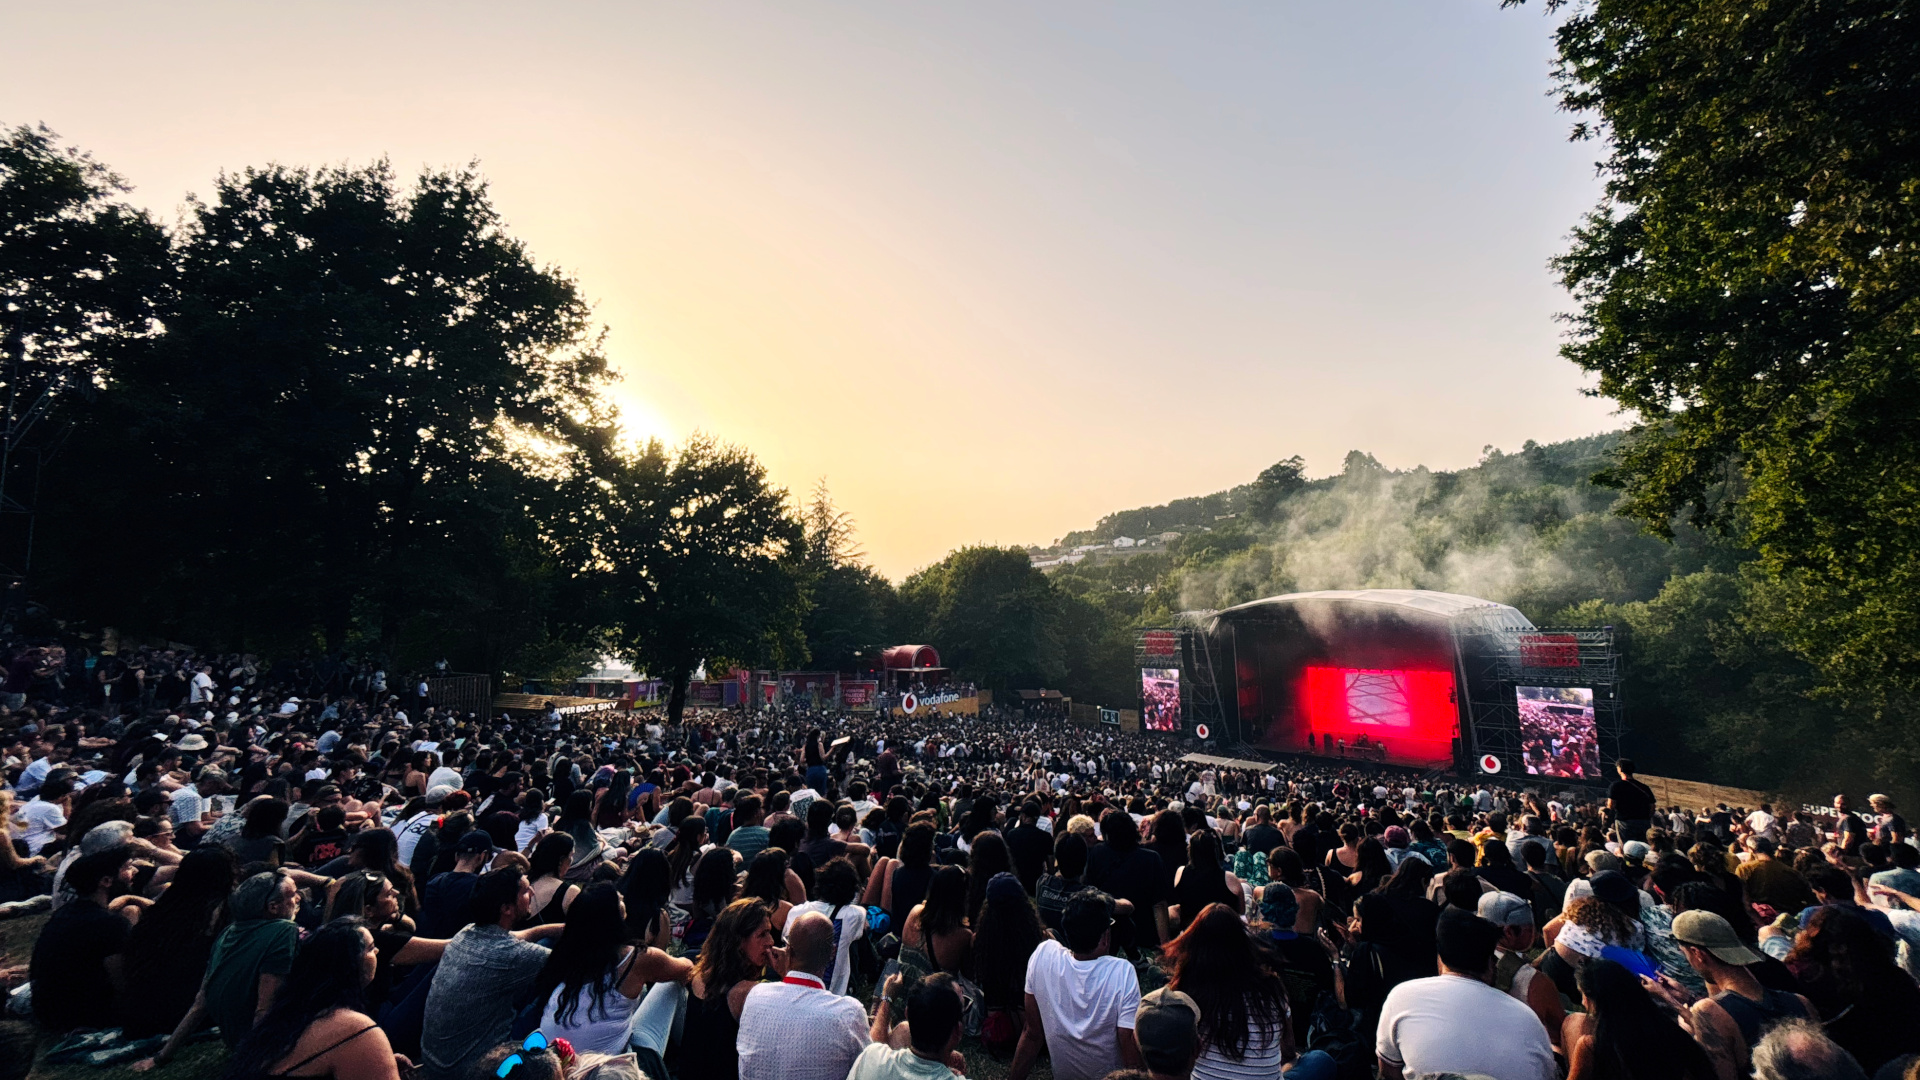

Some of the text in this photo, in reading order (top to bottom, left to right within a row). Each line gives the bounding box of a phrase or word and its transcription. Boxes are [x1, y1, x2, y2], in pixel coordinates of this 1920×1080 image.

[919, 692, 960, 706] vodafone
[576, 704, 596, 713] BOCK
[597, 701, 618, 711] SKY
[1801, 803, 1838, 818] SUPE
[1041, 889, 1068, 902] Billabo
